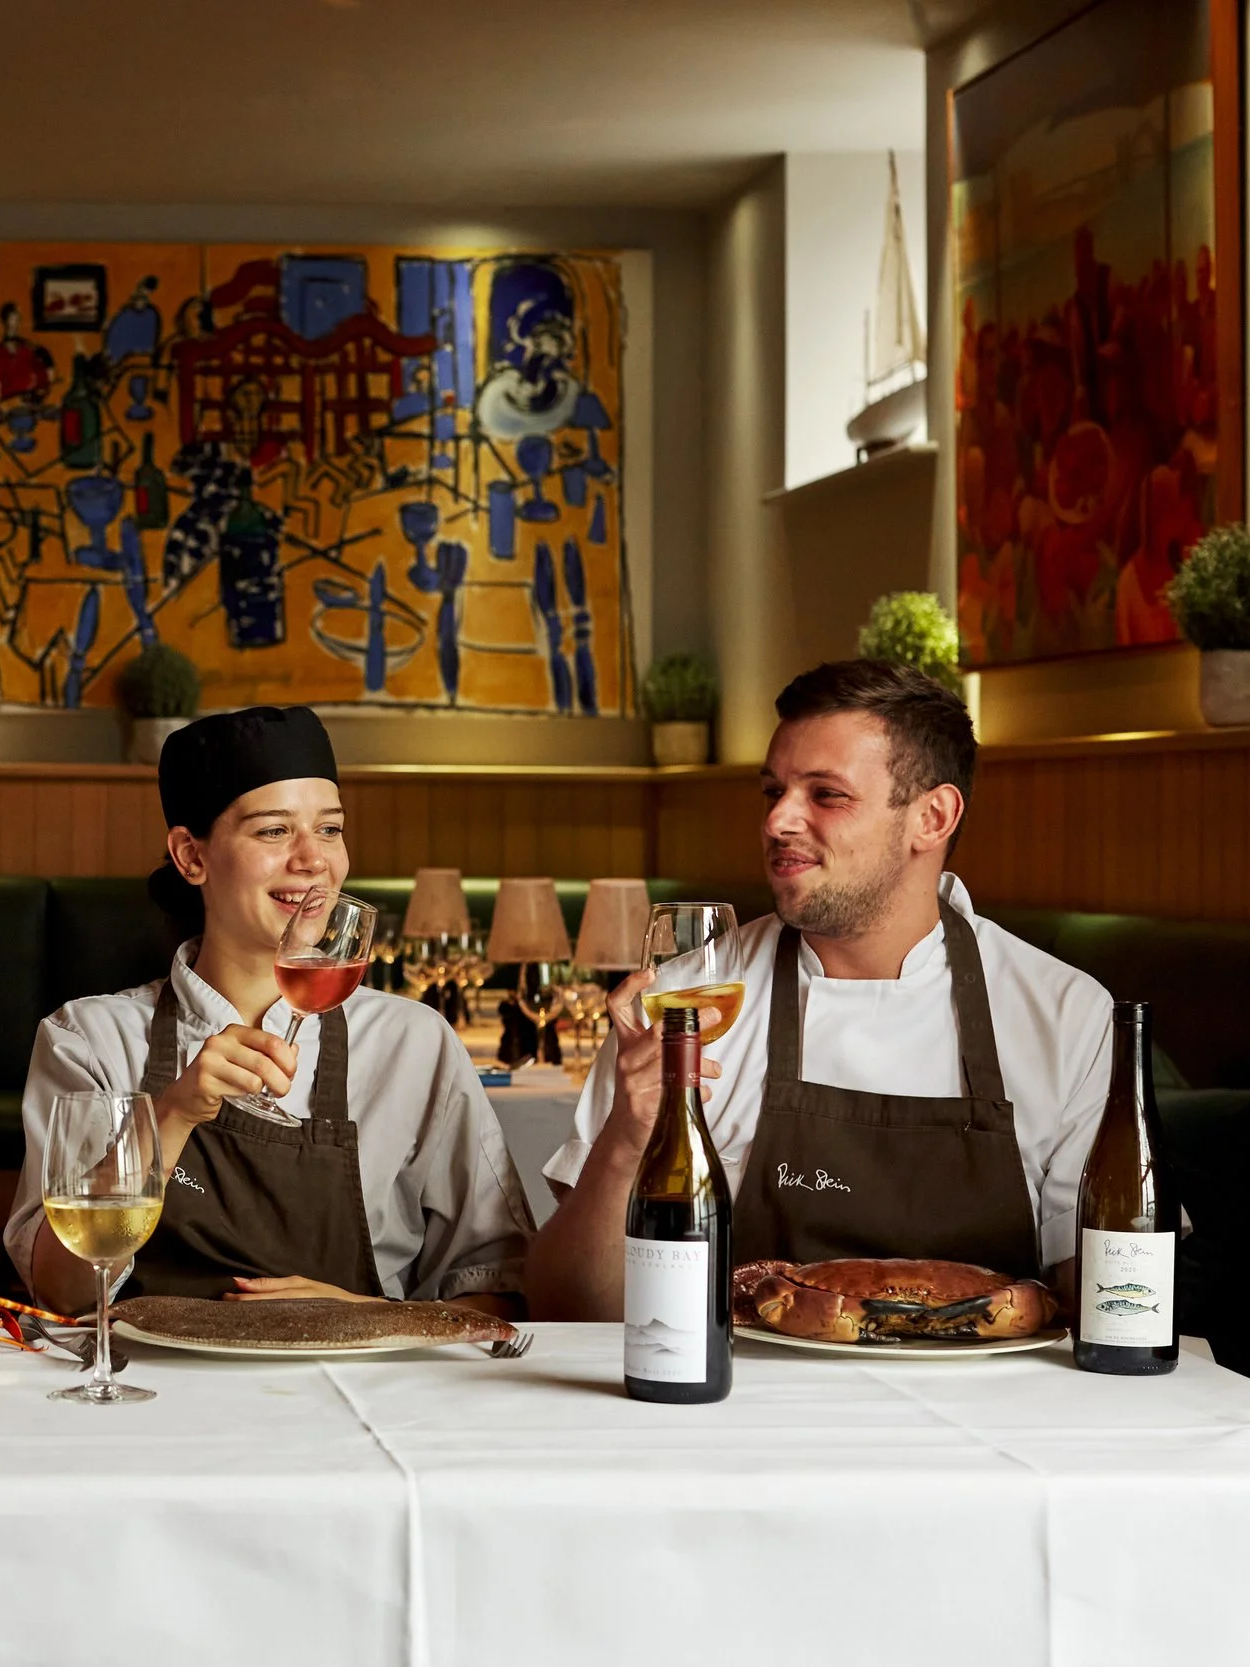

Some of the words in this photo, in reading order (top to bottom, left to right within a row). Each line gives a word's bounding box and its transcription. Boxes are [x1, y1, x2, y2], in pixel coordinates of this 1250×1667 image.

[777, 1162, 814, 1191] Rick
[815, 1169, 851, 1193] Stein
[624, 1245, 664, 1260] LOUDY
[672, 1250, 701, 1262] BAY
